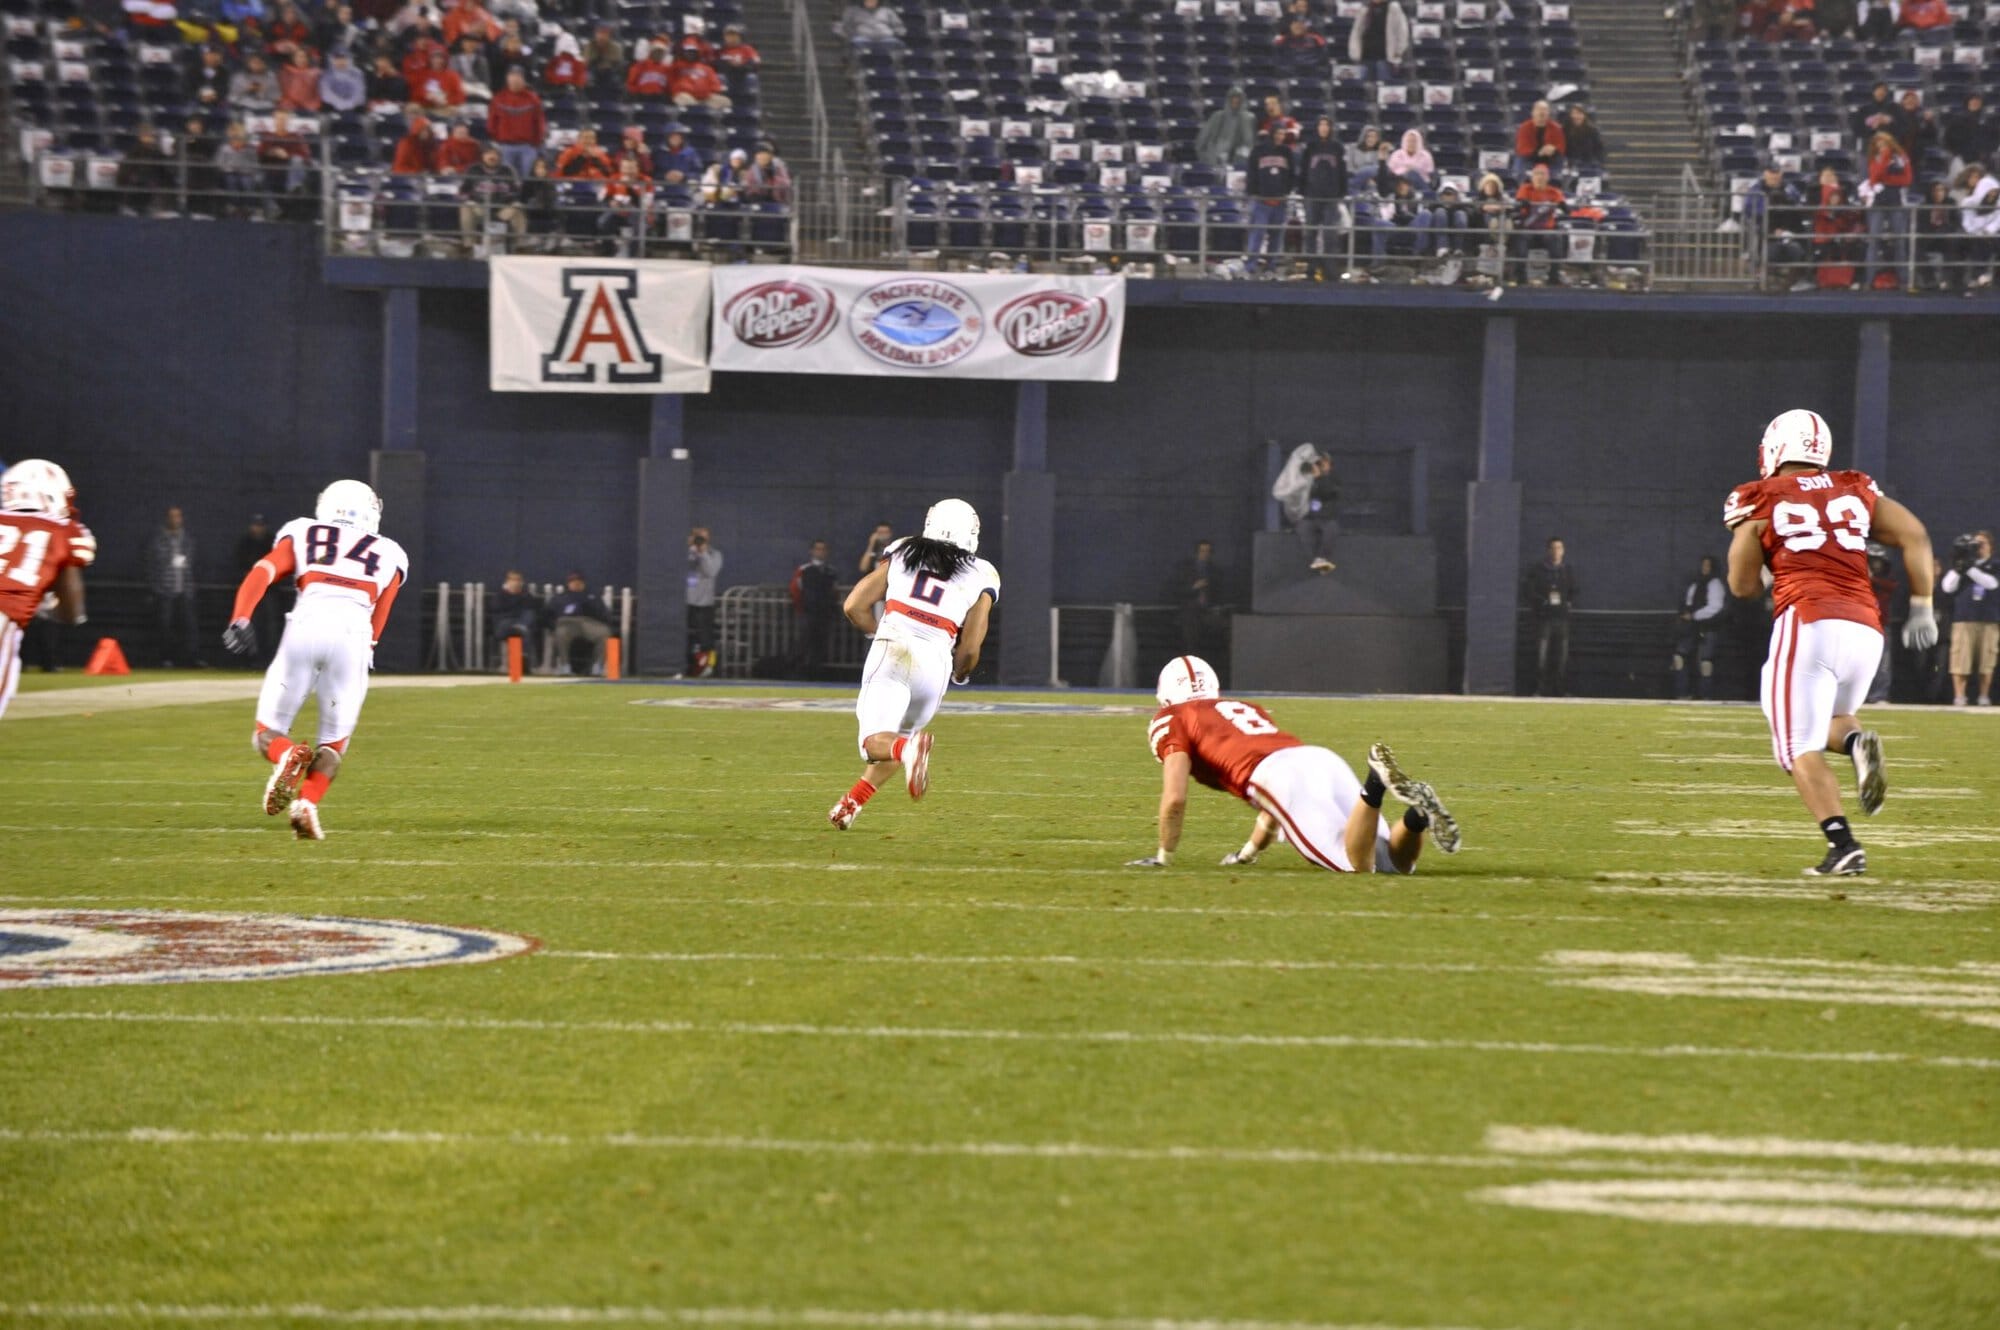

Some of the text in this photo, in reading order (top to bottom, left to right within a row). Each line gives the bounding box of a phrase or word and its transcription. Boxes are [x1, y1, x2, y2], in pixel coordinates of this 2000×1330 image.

[765, 290, 799, 316] Dr
[868, 282, 966, 311] PACIFIC LIFE
[1039, 300, 1072, 325] Dr
[541, 267, 662, 384] A
[739, 296, 818, 340] Pepper
[1011, 304, 1091, 349] Pepper
[858, 329, 973, 364] HOLIDAY BOWL
[1796, 473, 1834, 492] SUH
[1772, 495, 1872, 553] 93
[305, 524, 382, 578] 84
[1214, 700, 1280, 736] 8
